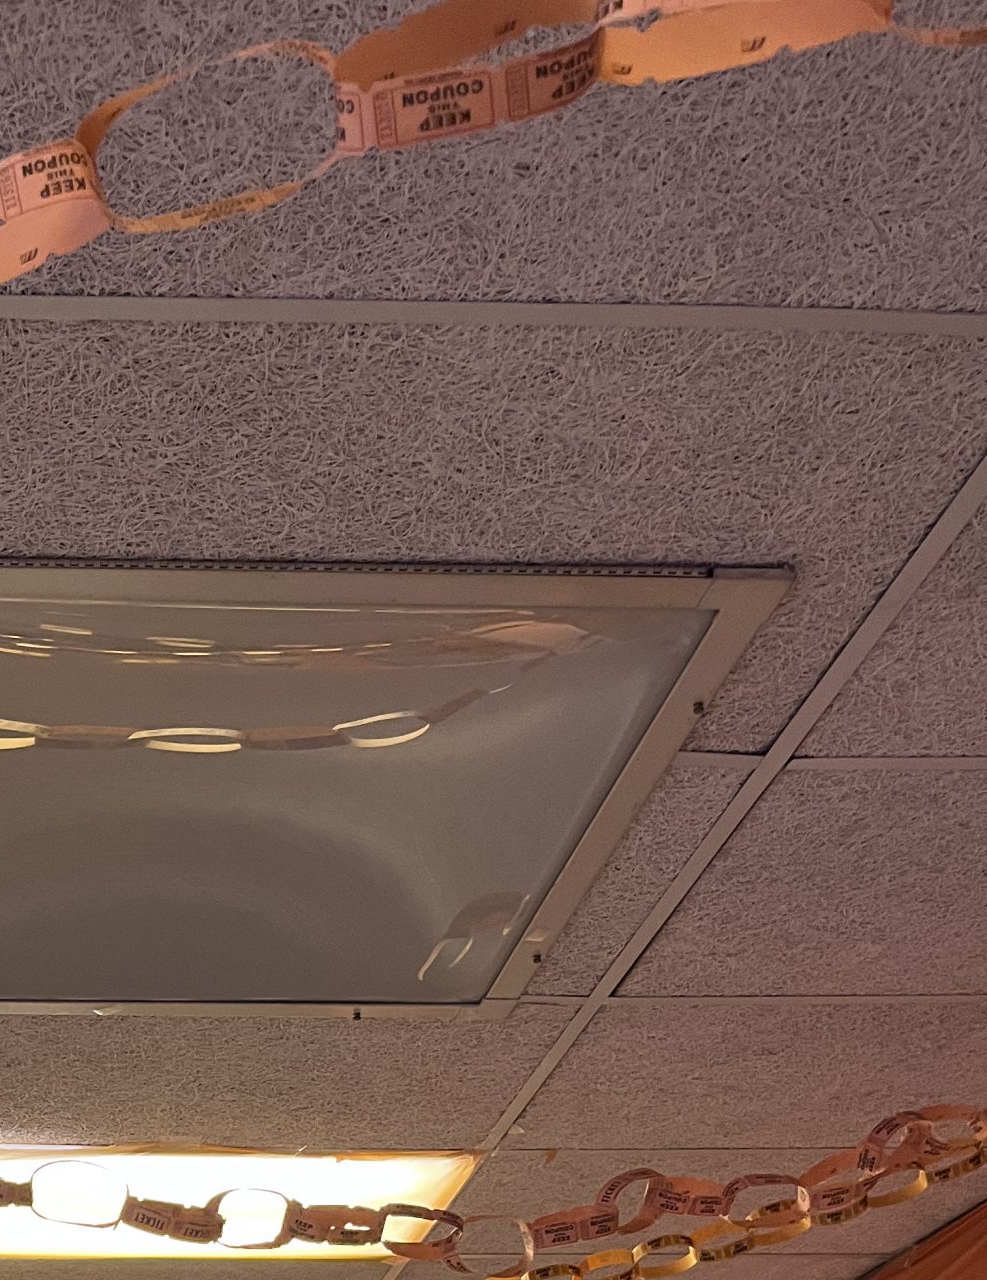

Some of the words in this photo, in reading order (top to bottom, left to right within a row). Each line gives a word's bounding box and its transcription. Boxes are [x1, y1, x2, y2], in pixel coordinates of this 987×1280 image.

[402, 79, 484, 108] COUPON
[428, 100, 459, 112] THIS
[420, 109, 471, 132] KEEP
[22, 152, 88, 178] COUPON
[47, 168, 75, 181] THIS
[40, 177, 87, 199] KEEP
[134, 1212, 165, 1230] TICKET
[545, 1225, 574, 1234] COUPON
